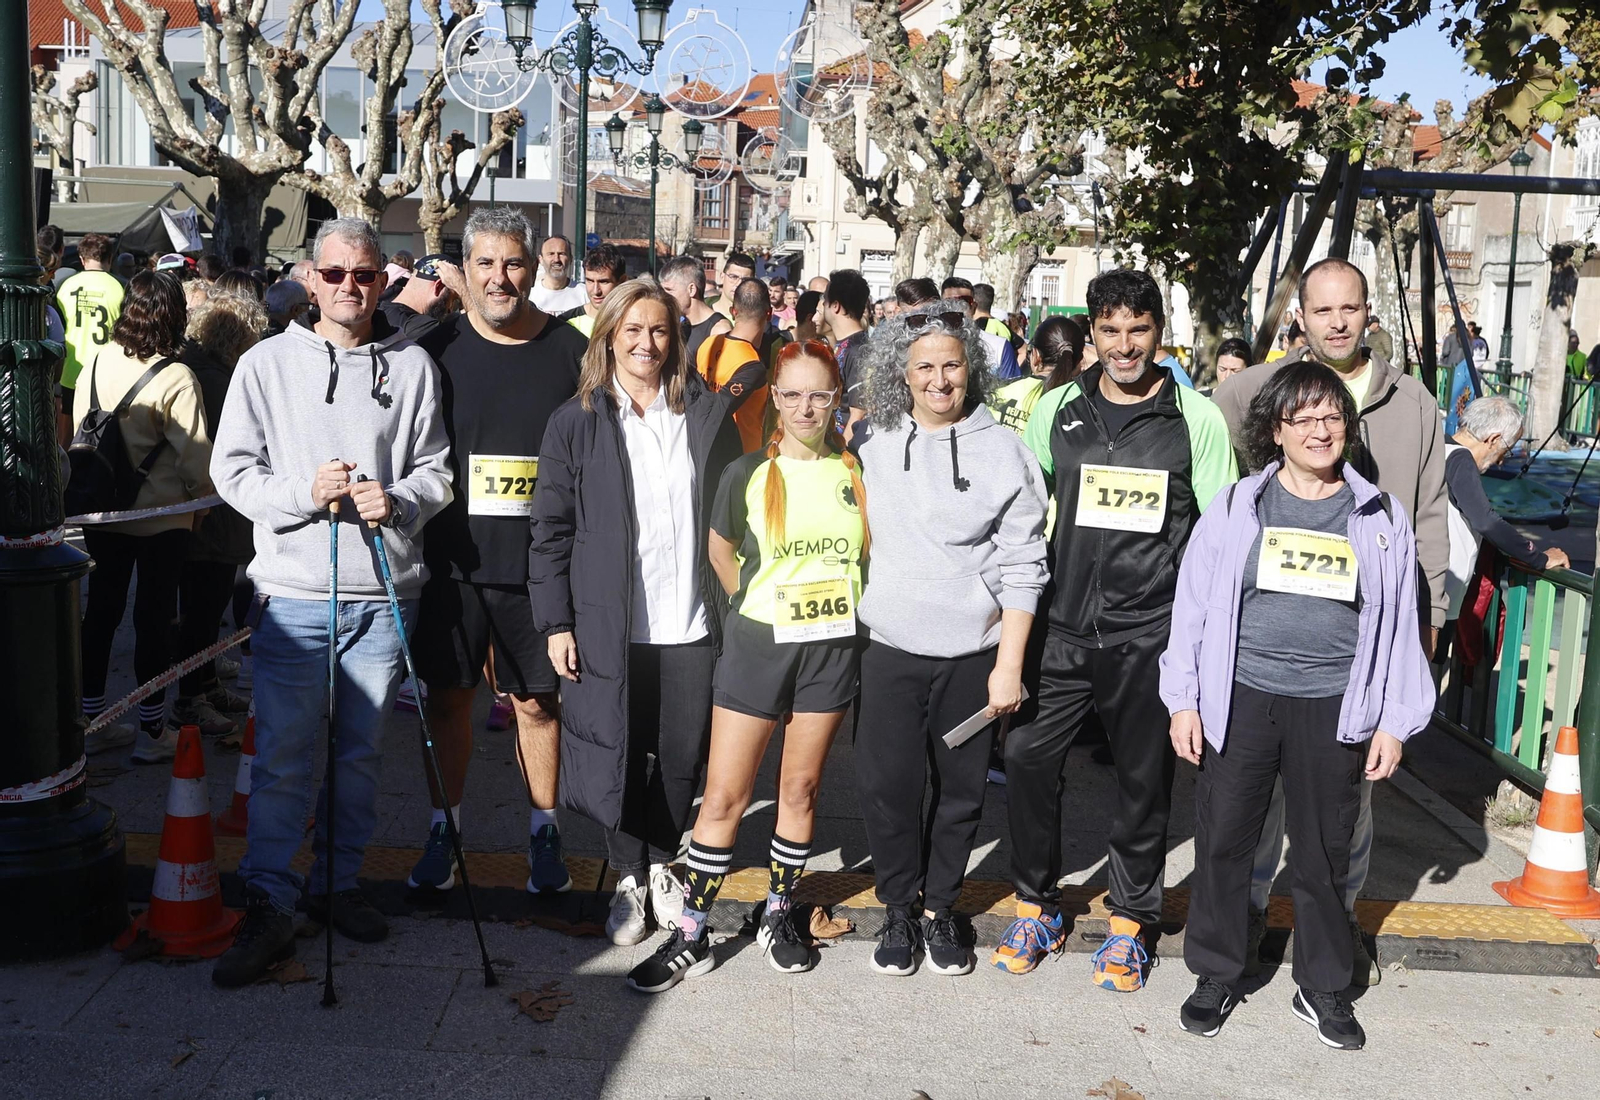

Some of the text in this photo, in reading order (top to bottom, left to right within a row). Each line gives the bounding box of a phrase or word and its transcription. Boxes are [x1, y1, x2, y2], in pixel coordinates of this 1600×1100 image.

[485, 476, 538, 495] 1727
[1097, 487, 1160, 511] 1722
[773, 537, 849, 560] AVEMPO
[1281, 549, 1350, 577] 1721
[790, 596, 849, 621] 1346
